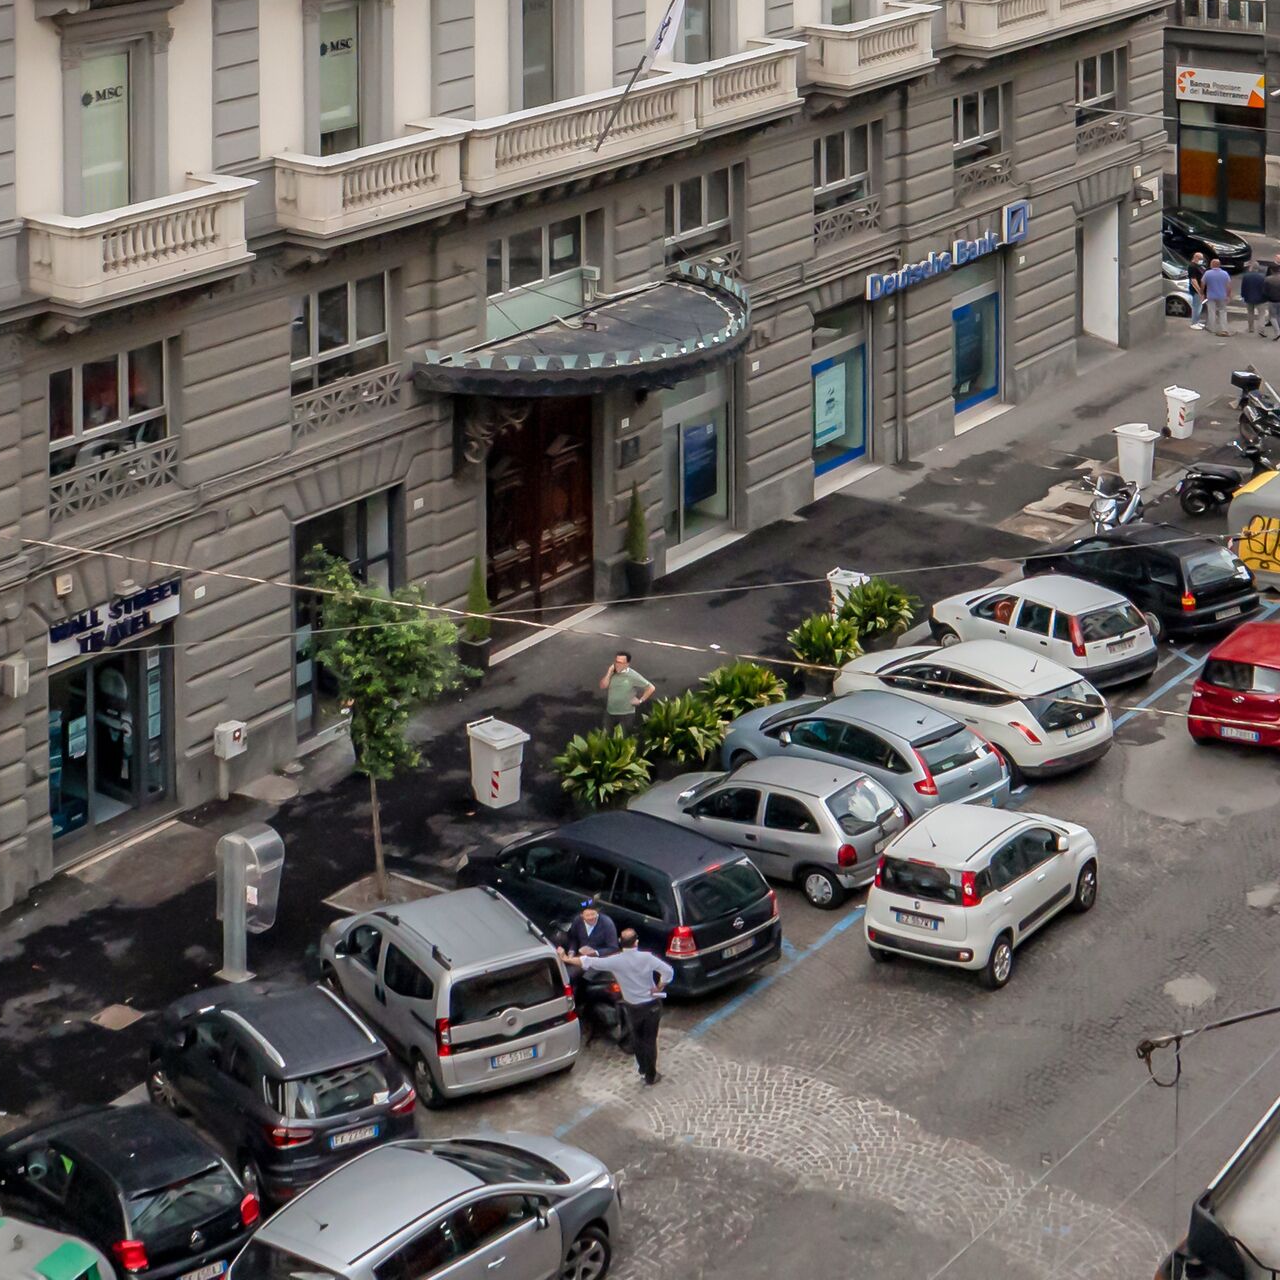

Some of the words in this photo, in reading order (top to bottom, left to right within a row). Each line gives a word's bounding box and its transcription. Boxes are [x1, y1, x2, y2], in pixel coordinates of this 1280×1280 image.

[330, 37, 354, 53] MSC
[1190, 79, 1211, 89] Banca
[95, 85, 124, 103] MSC
[1201, 88, 1249, 100] Mediterraneo
[865, 251, 953, 301] Deutsche
[952, 228, 999, 265] Bank
[48, 607, 104, 644] WALL
[76, 610, 158, 654] TRAVEL
